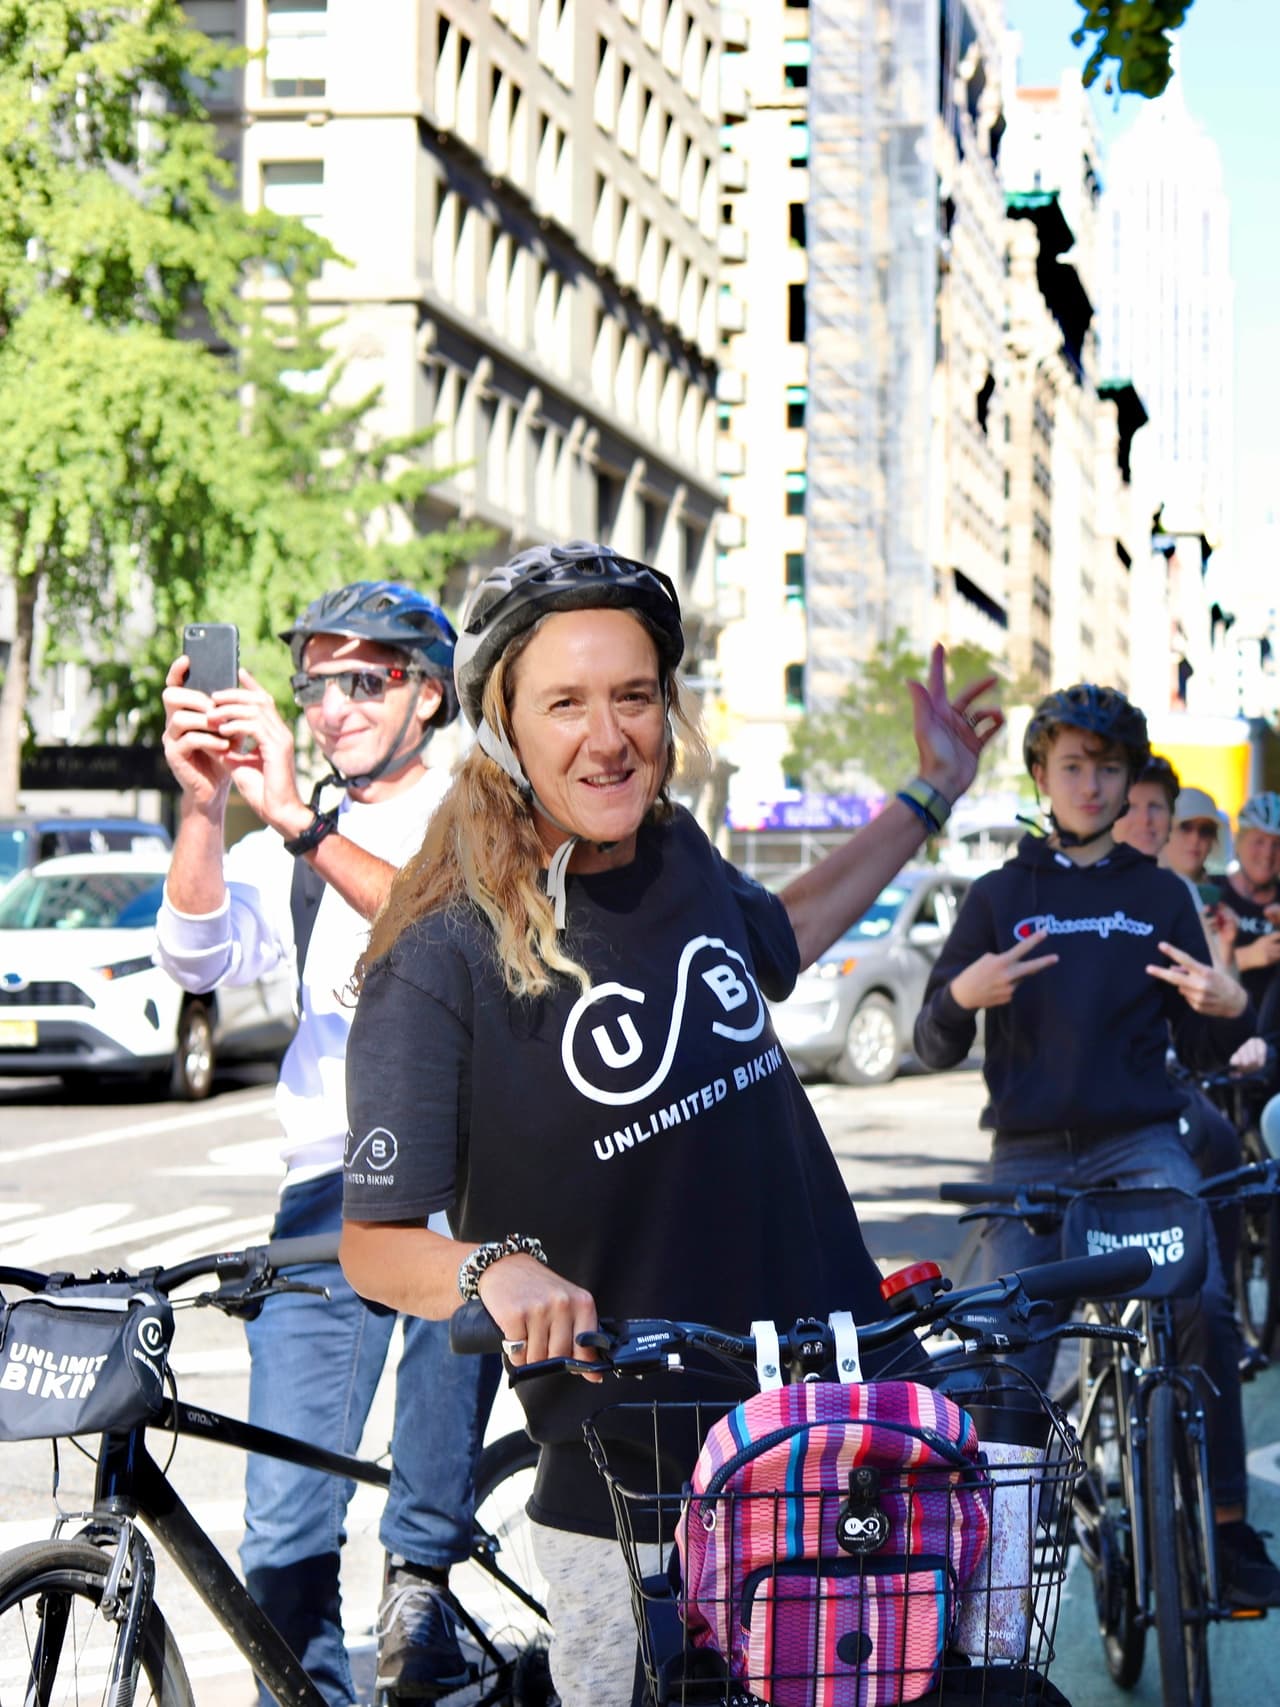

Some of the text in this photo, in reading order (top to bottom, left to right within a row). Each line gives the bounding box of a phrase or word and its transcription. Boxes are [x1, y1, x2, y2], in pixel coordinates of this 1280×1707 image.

[591, 964, 748, 1069] U B
[593, 1078, 727, 1160] UNLIMITED
[1086, 1226, 1184, 1249] UNLIMITED
